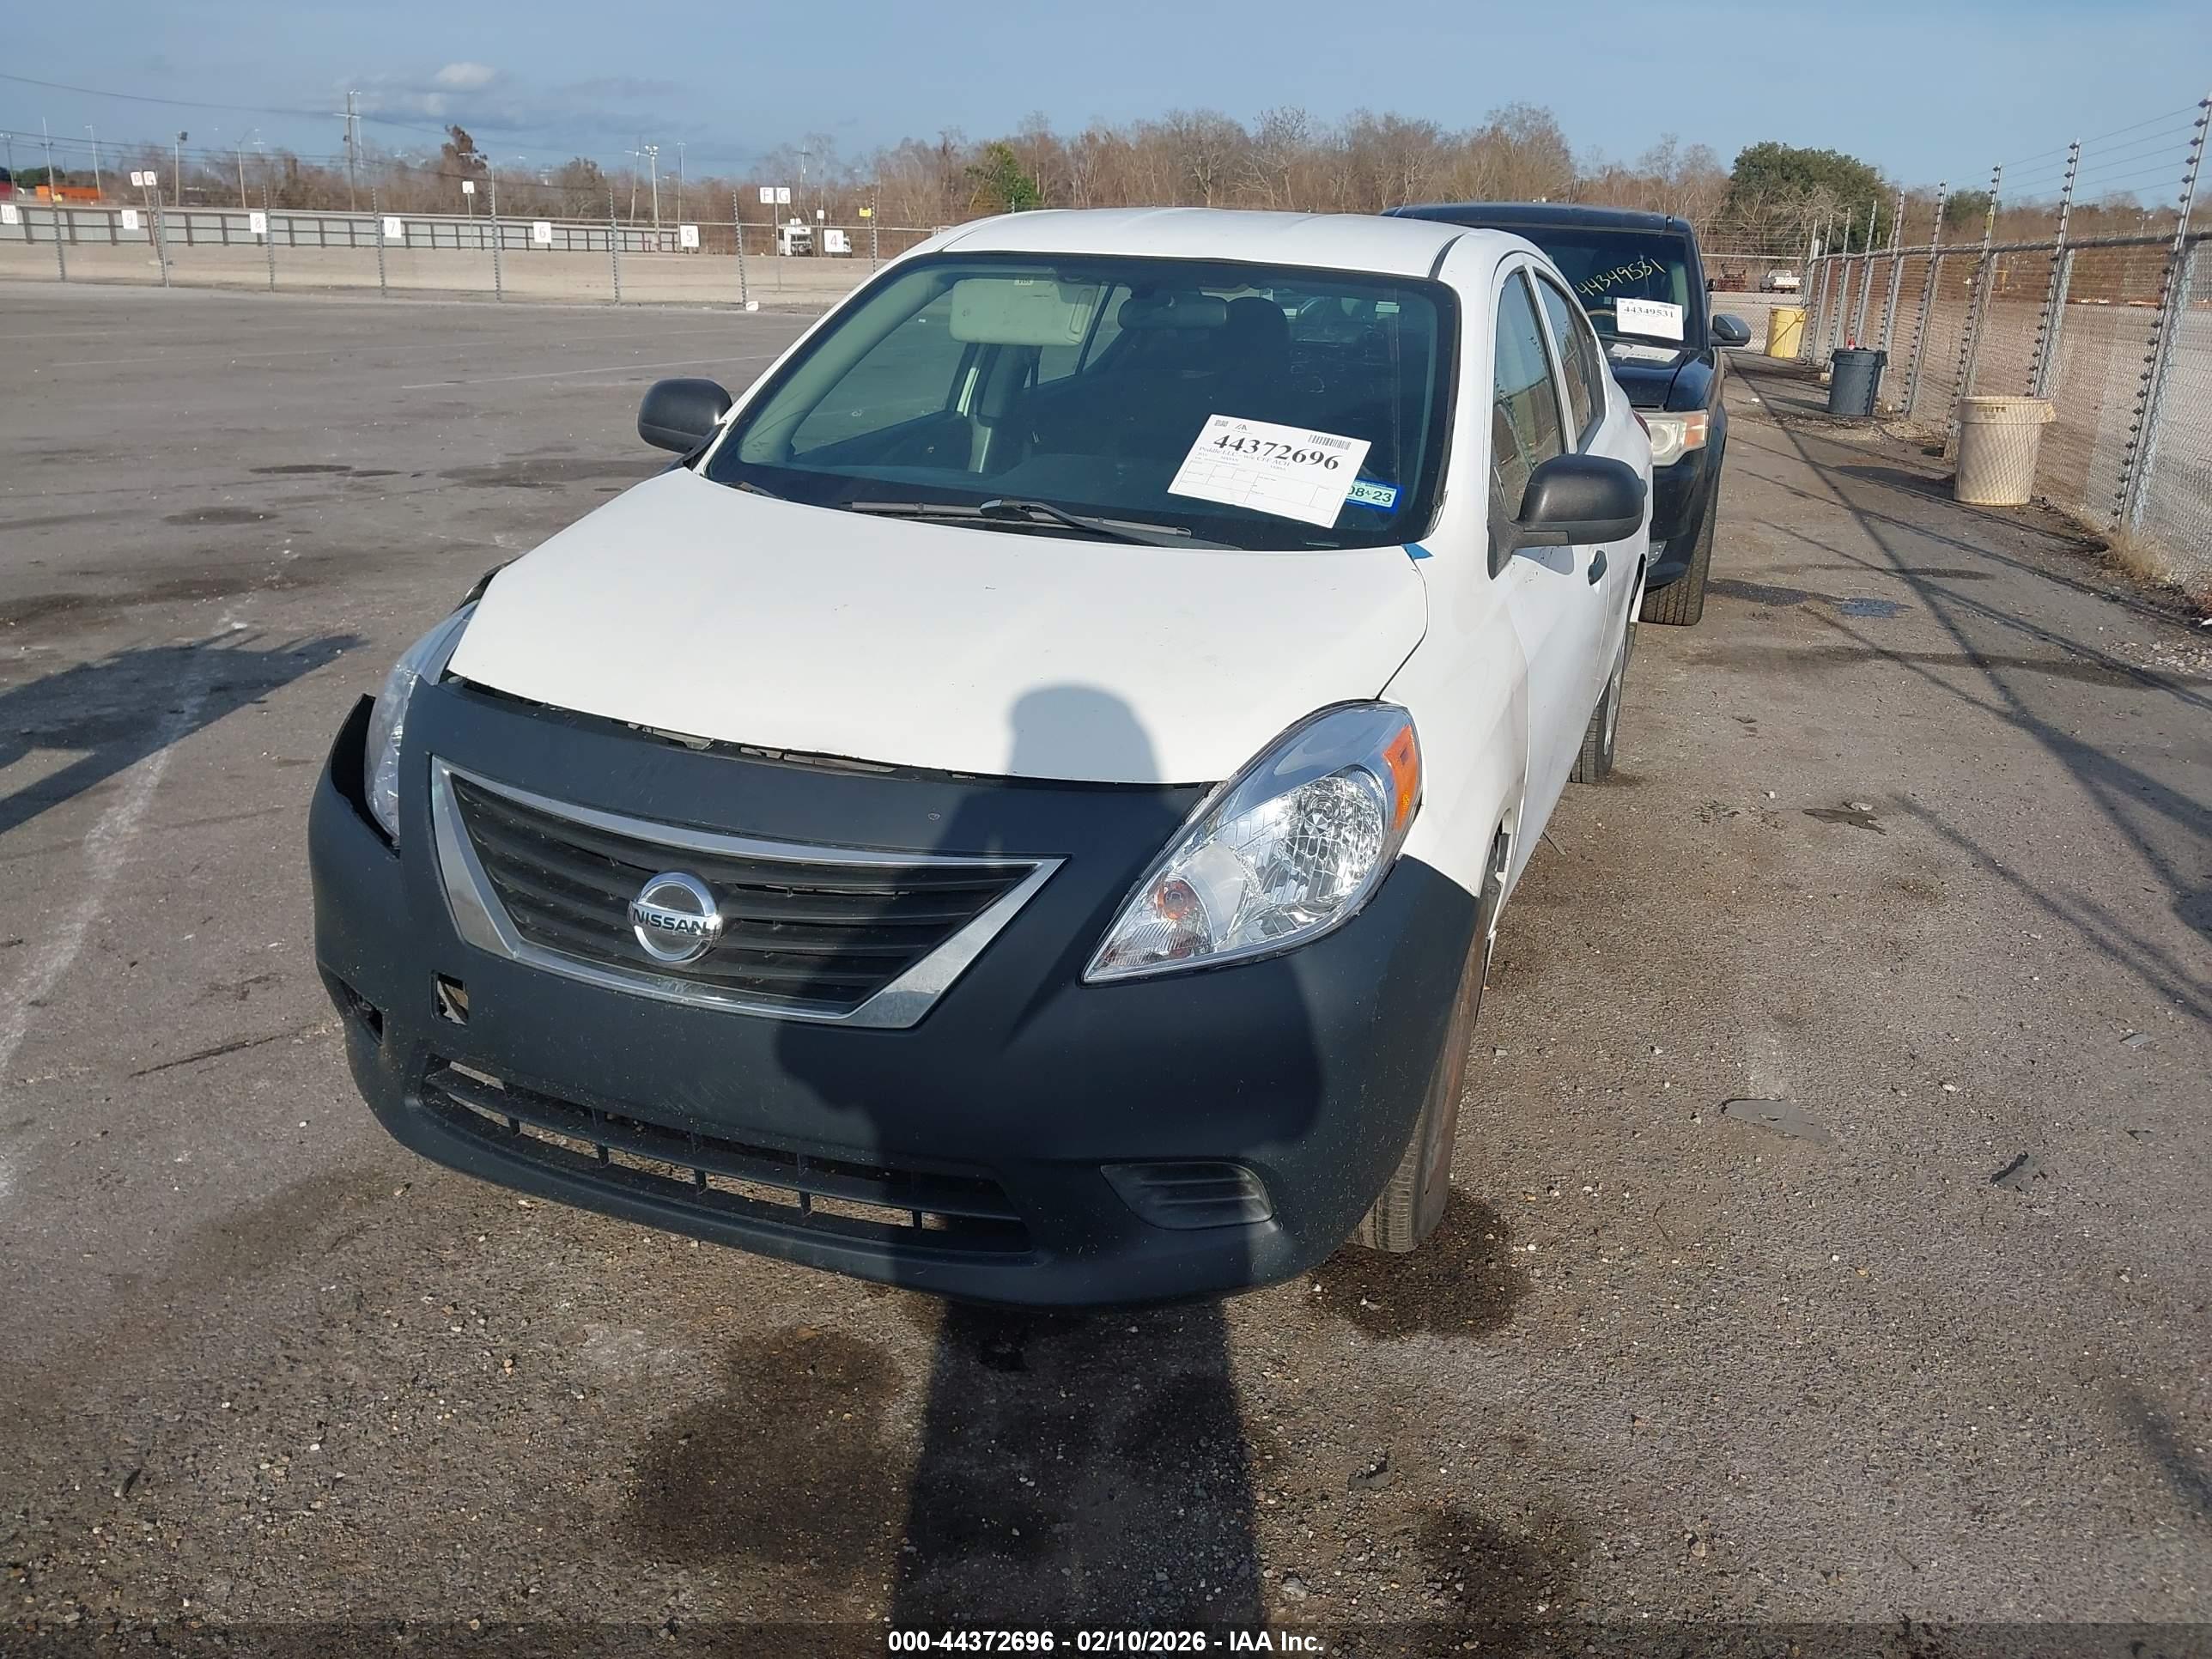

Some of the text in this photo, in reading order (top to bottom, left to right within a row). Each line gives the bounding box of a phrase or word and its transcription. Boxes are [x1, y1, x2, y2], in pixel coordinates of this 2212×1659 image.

[763, 189, 771, 202] F
[779, 190, 788, 202] G
[3, 207, 15, 221] 10
[126, 213, 133, 225] 9
[254, 216, 261, 228] 8
[389, 220, 396, 234] 7
[538, 226, 546, 239] 6
[686, 229, 694, 242] 5
[830, 234, 838, 248] 4
[1574, 258, 1667, 297] 44349531
[1624, 306, 1674, 319] 44349531
[1213, 434, 1342, 470] 44372696
[1372, 490, 1392, 502] 23
[633, 908, 708, 935] NISSAN
